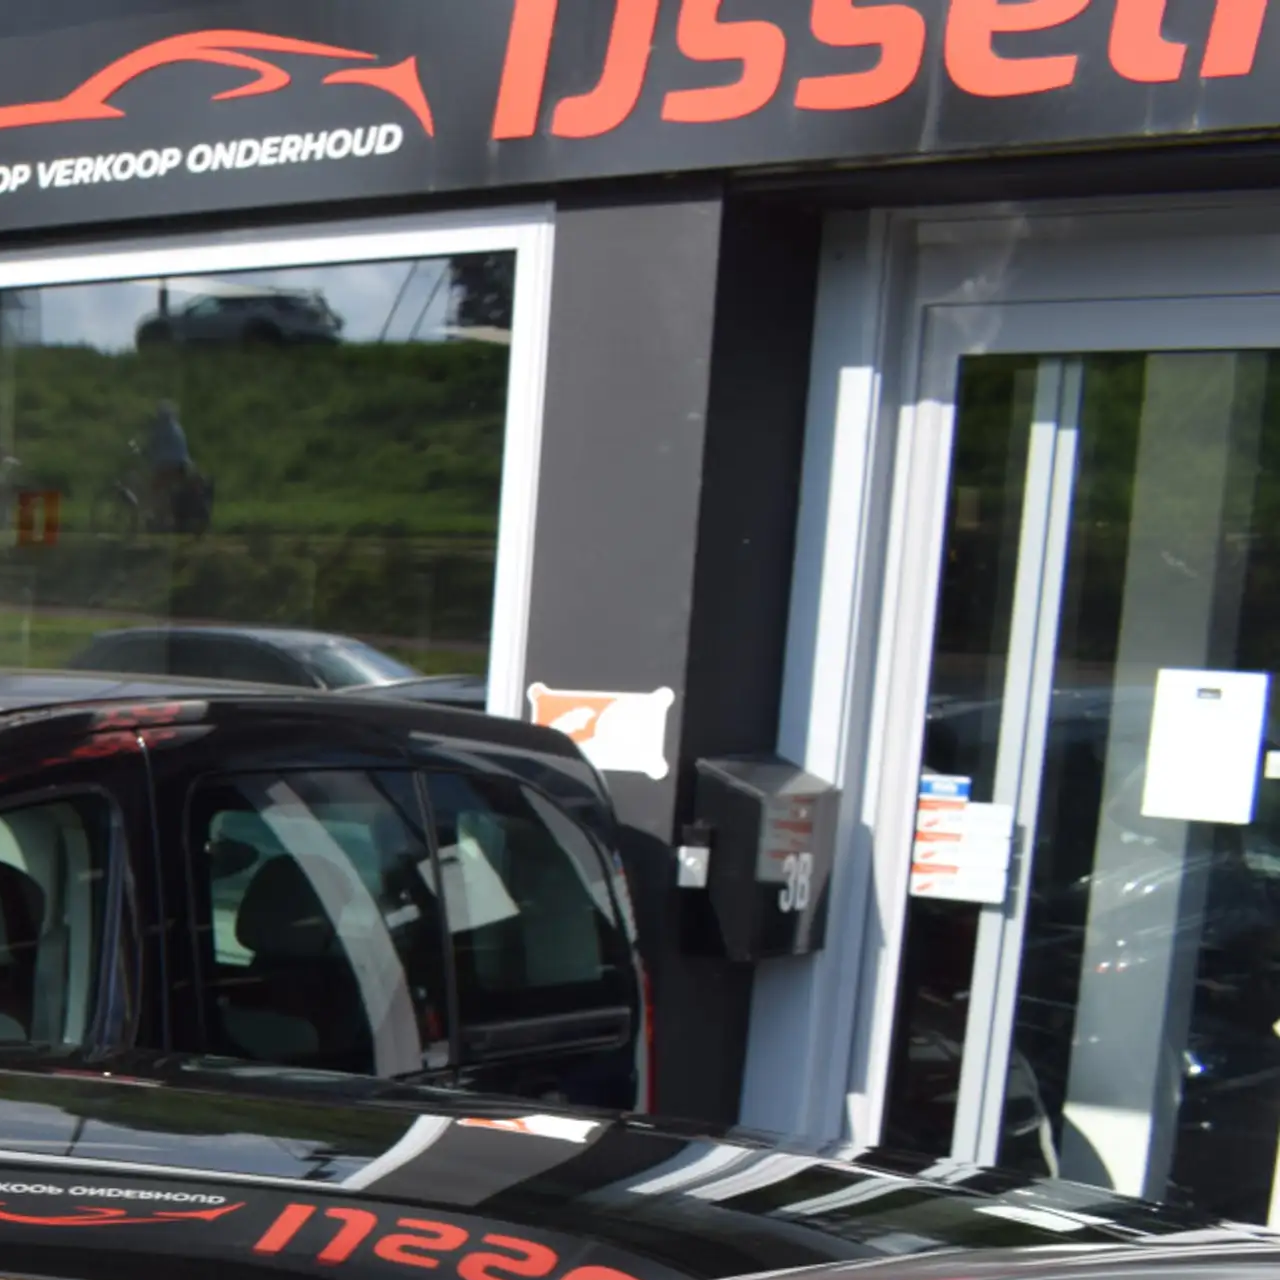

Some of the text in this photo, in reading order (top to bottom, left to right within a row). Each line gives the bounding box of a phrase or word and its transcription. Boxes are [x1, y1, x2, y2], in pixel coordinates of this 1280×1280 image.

[491, 0, 1269, 140] IJsse
[37, 146, 183, 189] VERKOOP
[186, 122, 404, 174] ONDERHOUD
